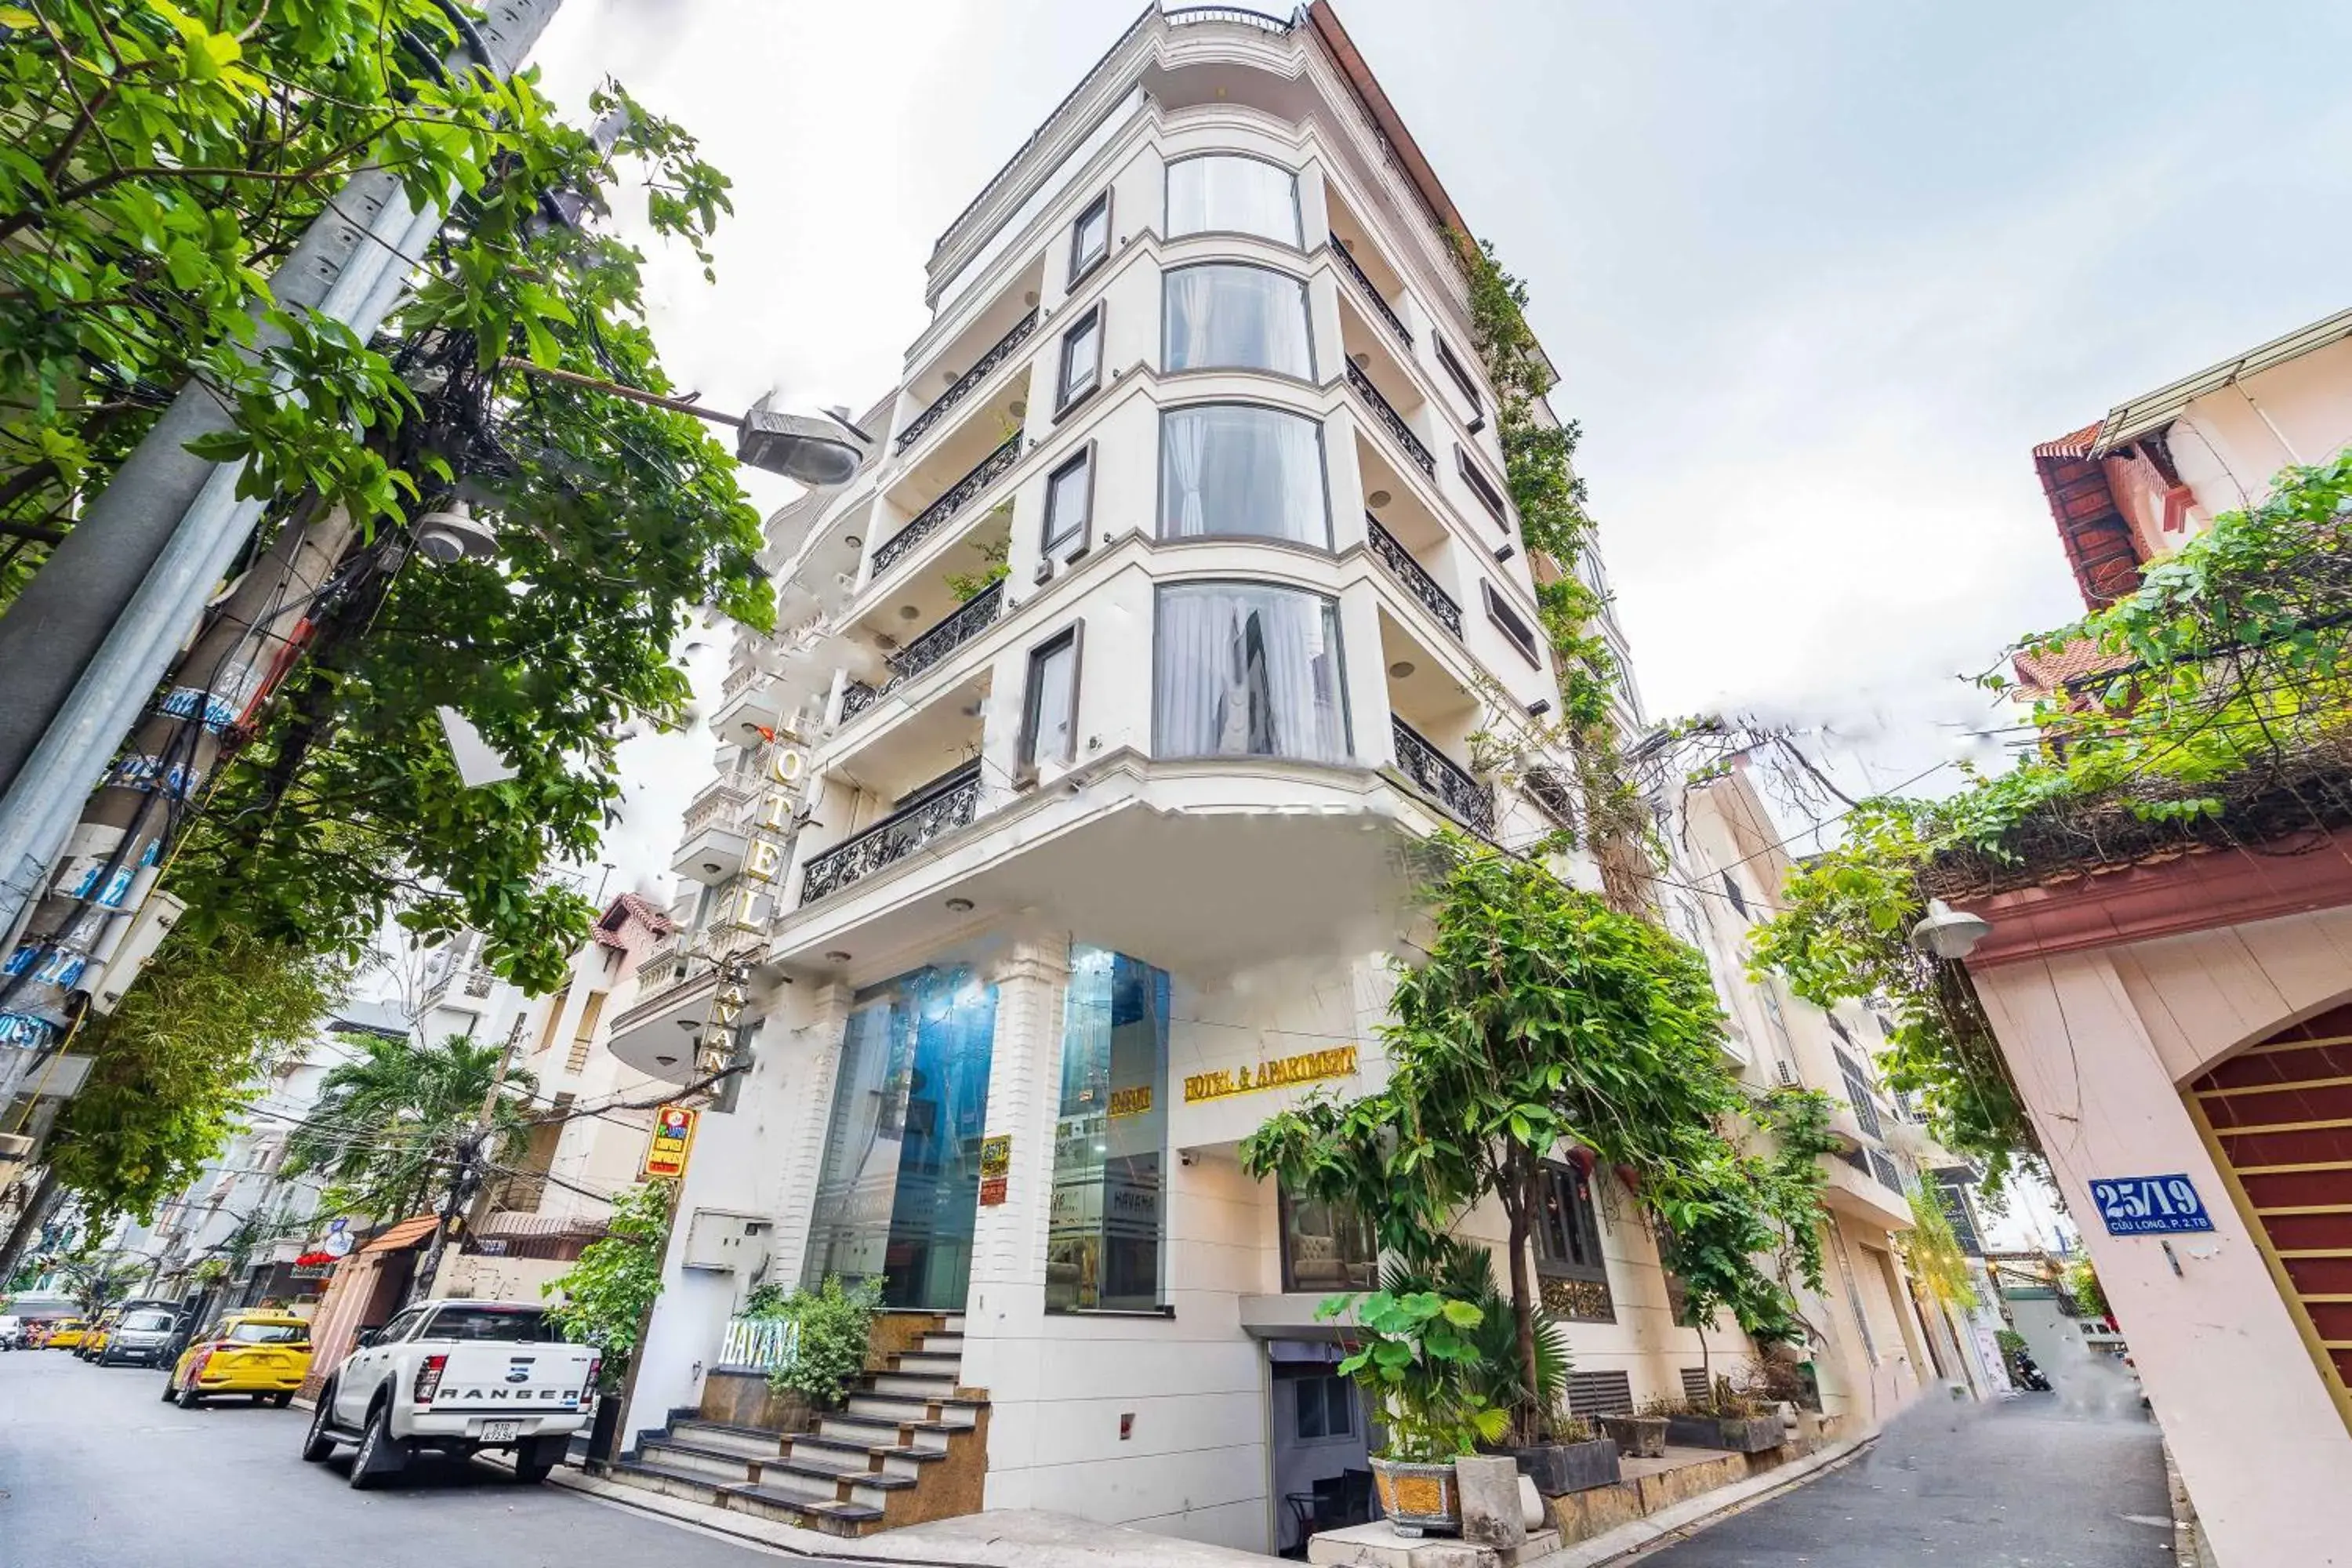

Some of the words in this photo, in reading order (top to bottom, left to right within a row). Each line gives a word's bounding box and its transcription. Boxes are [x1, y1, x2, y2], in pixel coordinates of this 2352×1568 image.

[1255, 1045, 1358, 1088] APARTMENT
[2096, 1180, 2198, 1218] 25/19
[718, 1320, 799, 1367] HAVANA
[439, 1388, 579, 1399] RANGER
